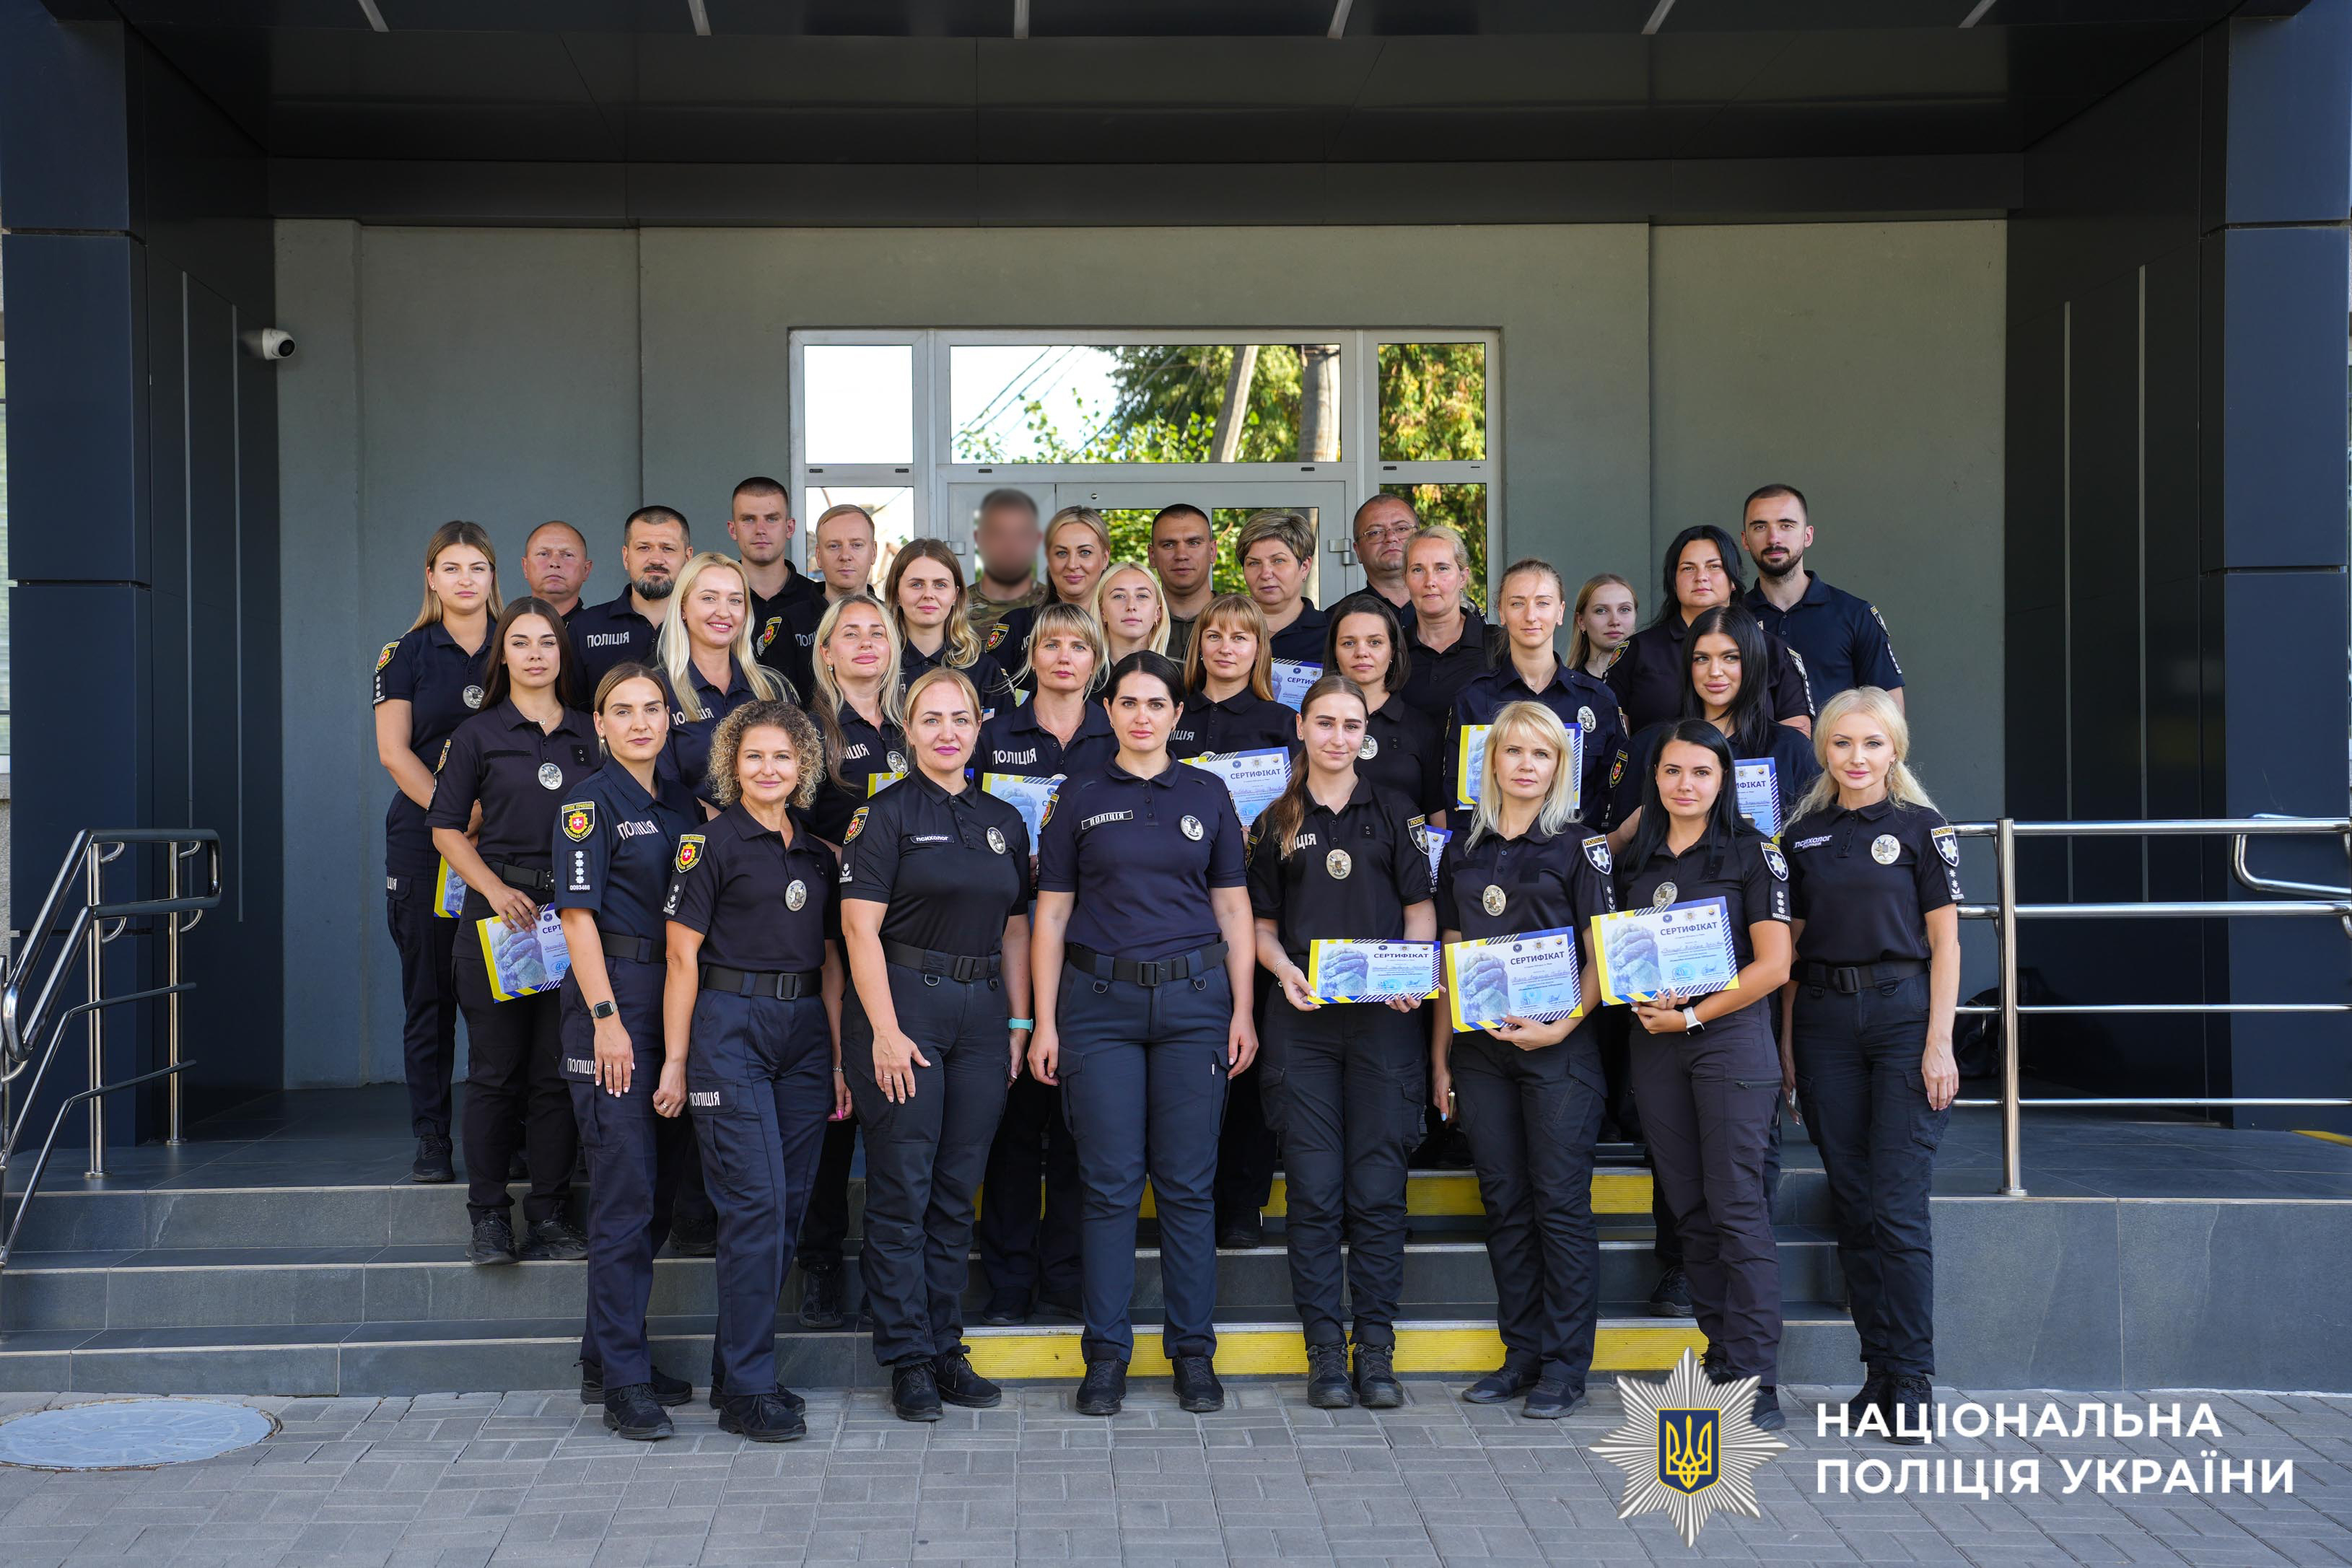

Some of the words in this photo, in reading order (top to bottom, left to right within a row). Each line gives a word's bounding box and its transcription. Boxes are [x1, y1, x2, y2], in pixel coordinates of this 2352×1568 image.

[587, 631, 629, 648] ПОЛІЦІЯ
[992, 748, 1037, 766] ПОЛІЦІЯ
[1230, 768, 1281, 779] СЕРТИФІКАТ
[1090, 813, 1124, 827] ПОЛІЦІЯ
[617, 820, 658, 840] ПОЛІЦІЯ
[1660, 921, 1718, 936] СЕРТИФІКАТ
[1511, 951, 1565, 965] СЕРТИФІКАТ
[689, 1092, 720, 1106] ПОЛІЦІЯ
